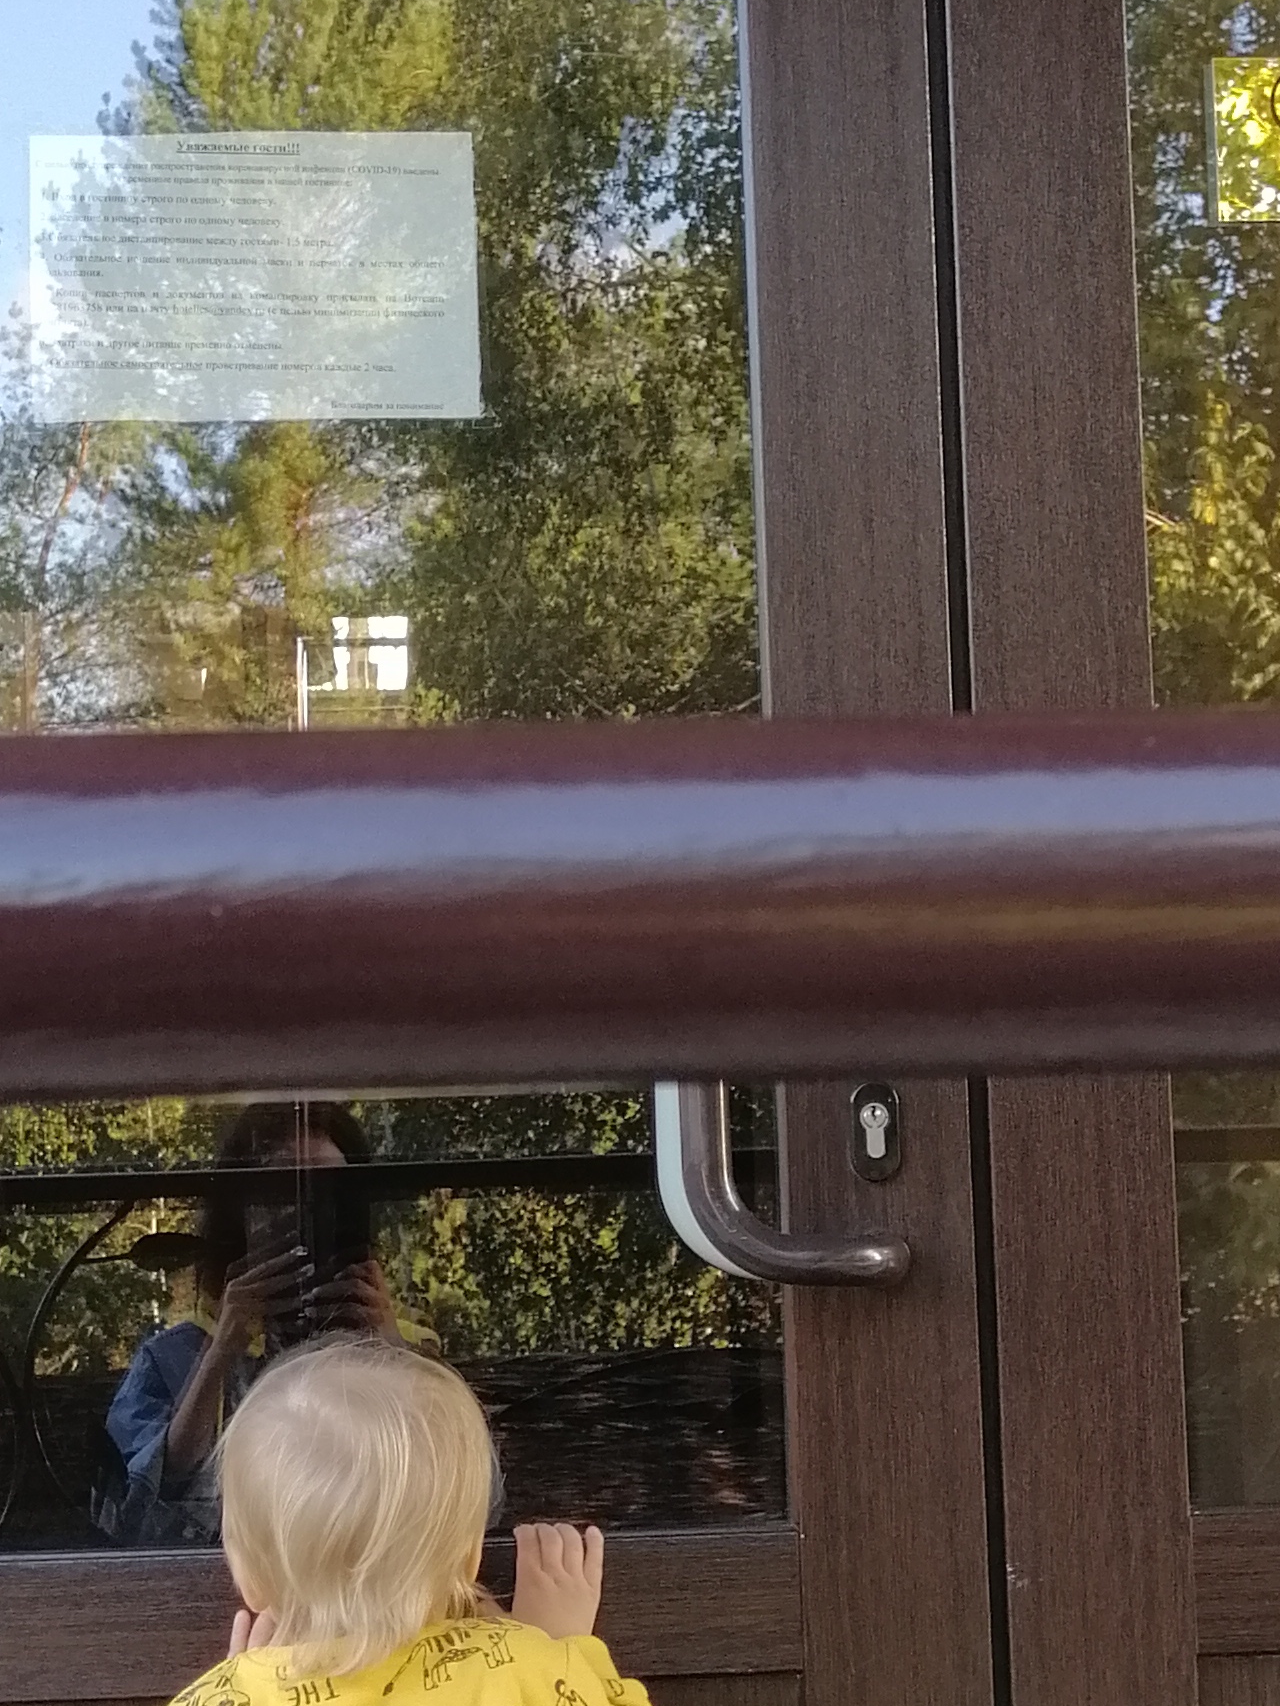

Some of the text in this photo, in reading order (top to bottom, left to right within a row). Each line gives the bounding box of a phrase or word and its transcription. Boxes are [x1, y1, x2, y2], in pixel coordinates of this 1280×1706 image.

[176, 141, 300, 155] Уважаемые гости!!!
[346, 165, 401, 176] (COVID-19)
[140, 195, 173, 205] строго
[190, 196, 225, 206] одному
[149, 216, 182, 225] строго
[363, 362, 370, 372] 2
[331, 400, 383, 411] Блаодарим
